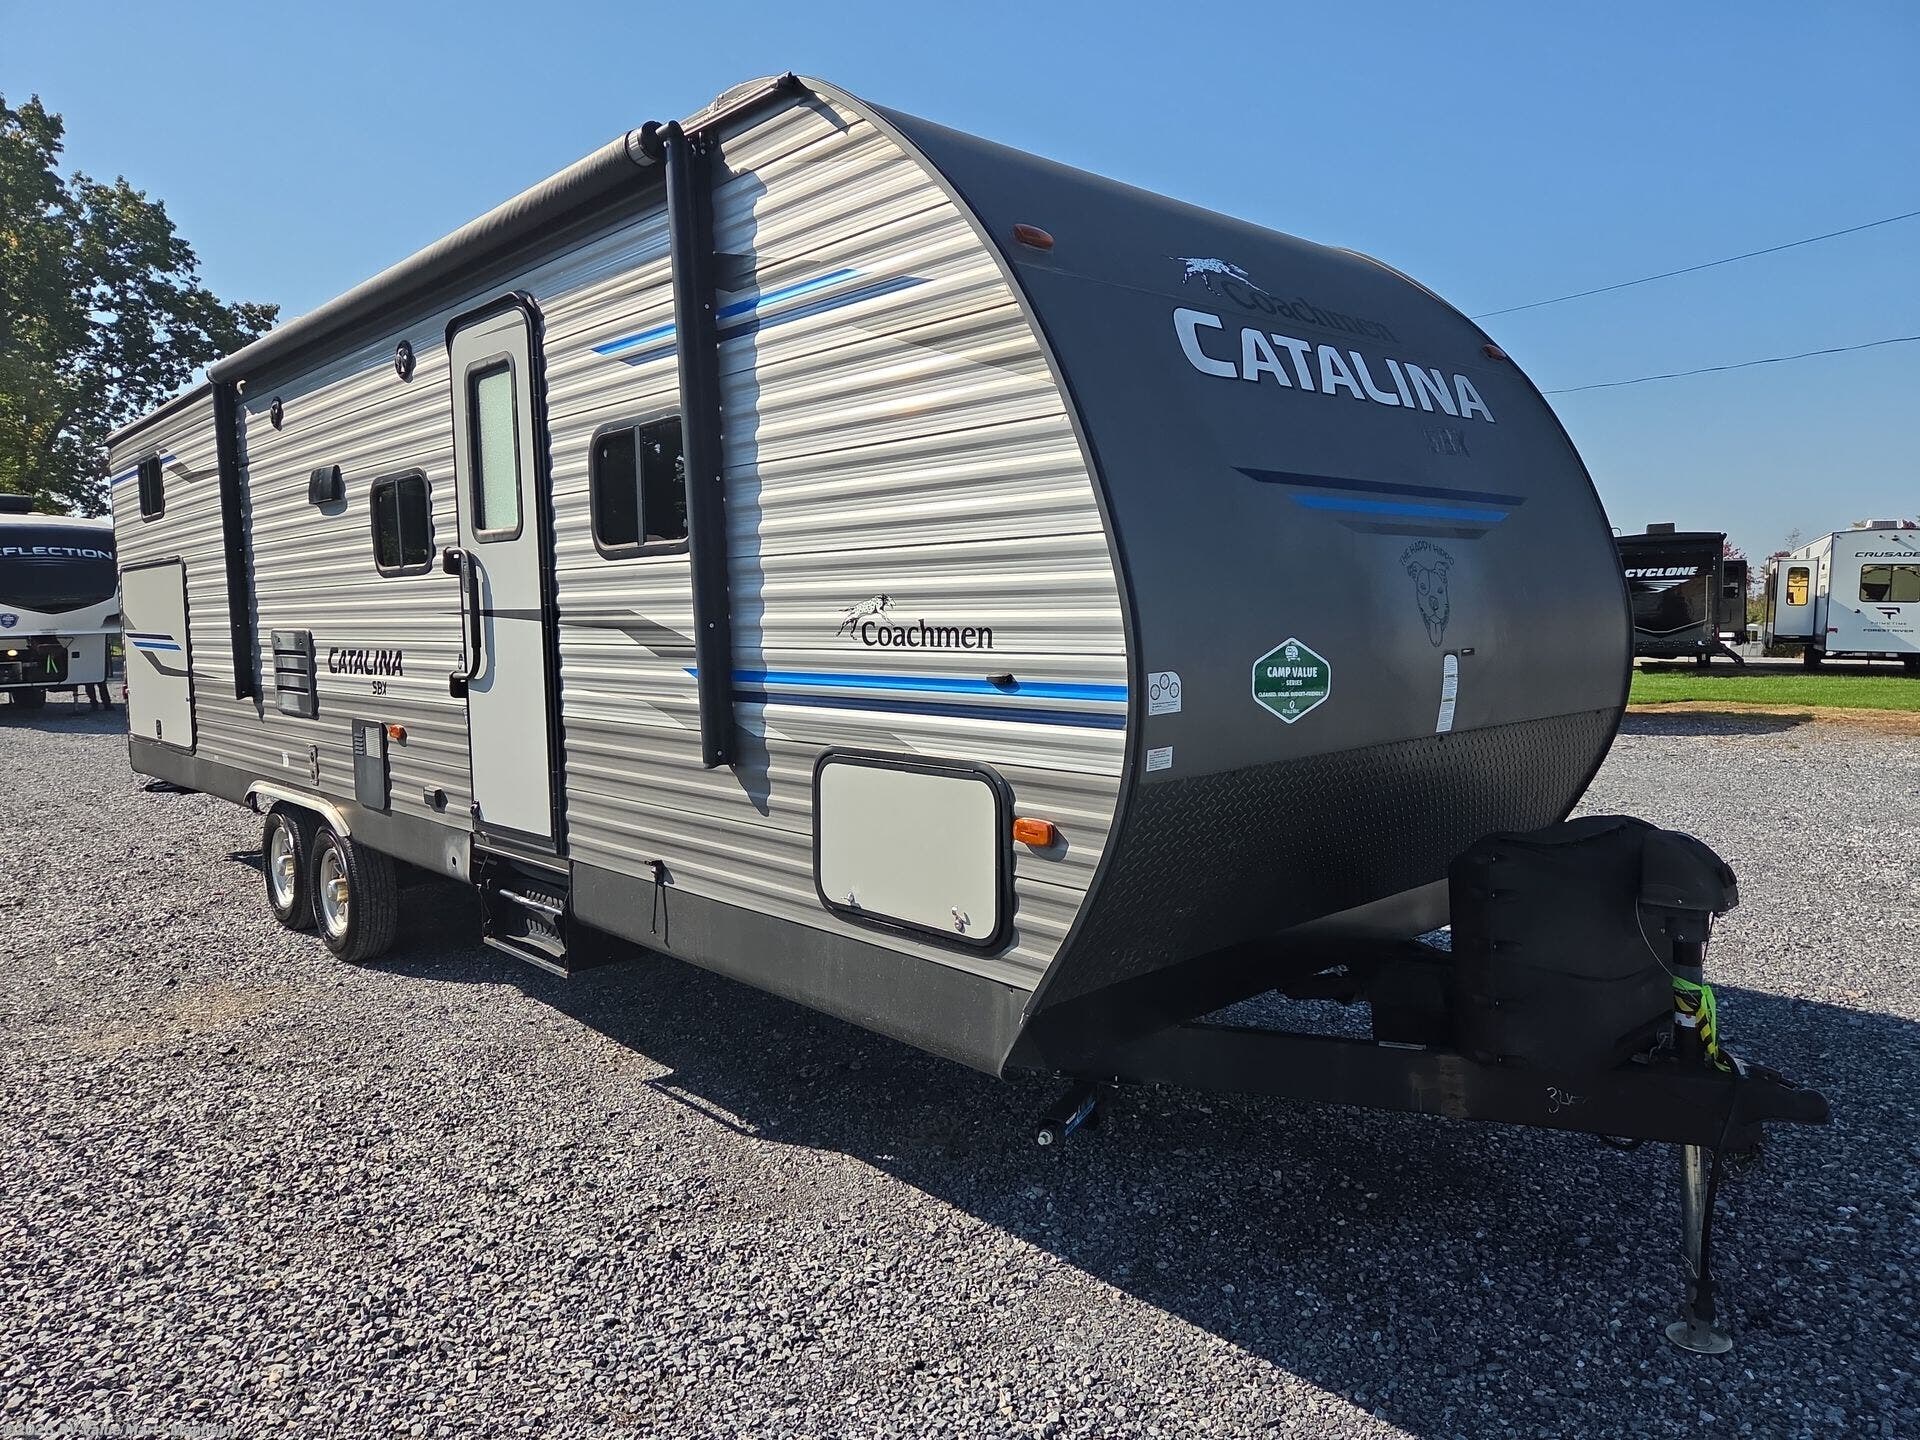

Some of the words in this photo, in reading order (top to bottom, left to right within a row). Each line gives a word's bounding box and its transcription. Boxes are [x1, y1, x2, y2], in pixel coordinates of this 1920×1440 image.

[1221, 281, 1400, 344] Coachmen
[1173, 307, 1496, 424] CATALINA
[0, 546, 113, 560] FLECTION
[1624, 566, 1698, 578] CYCLONE
[861, 618, 994, 649] Coachmen
[328, 647, 403, 676] CATALINA
[1267, 666, 1291, 678] CAMP
[1292, 666, 1318, 678] VALUE
[372, 680, 387, 695] SBX
